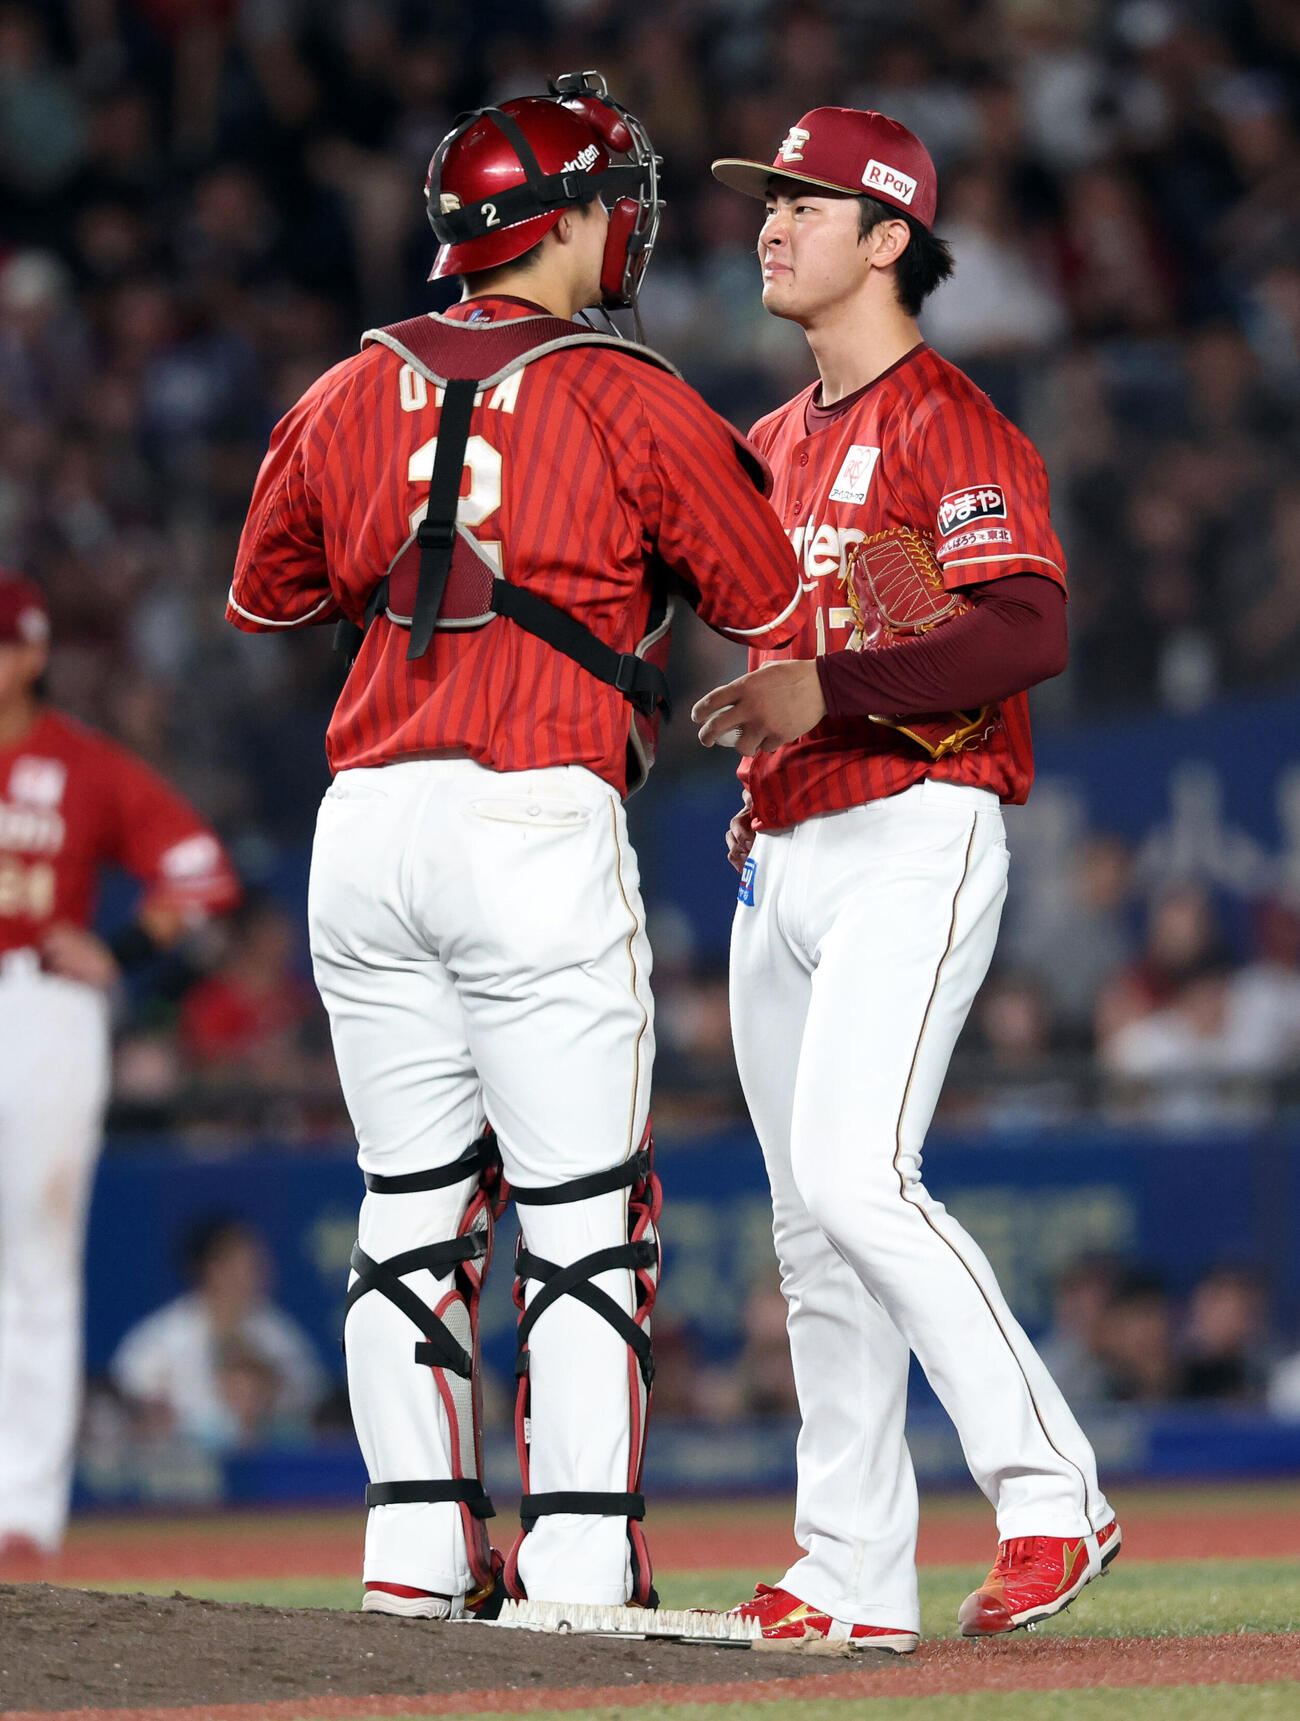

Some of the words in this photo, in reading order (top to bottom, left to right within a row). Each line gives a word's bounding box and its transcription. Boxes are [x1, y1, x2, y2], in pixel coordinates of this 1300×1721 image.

[869, 166, 881, 182] R
[883, 171, 912, 198] Pay
[481, 203, 500, 227] 2
[399, 363, 525, 414] OA
[940, 490, 1001, 529] やまや
